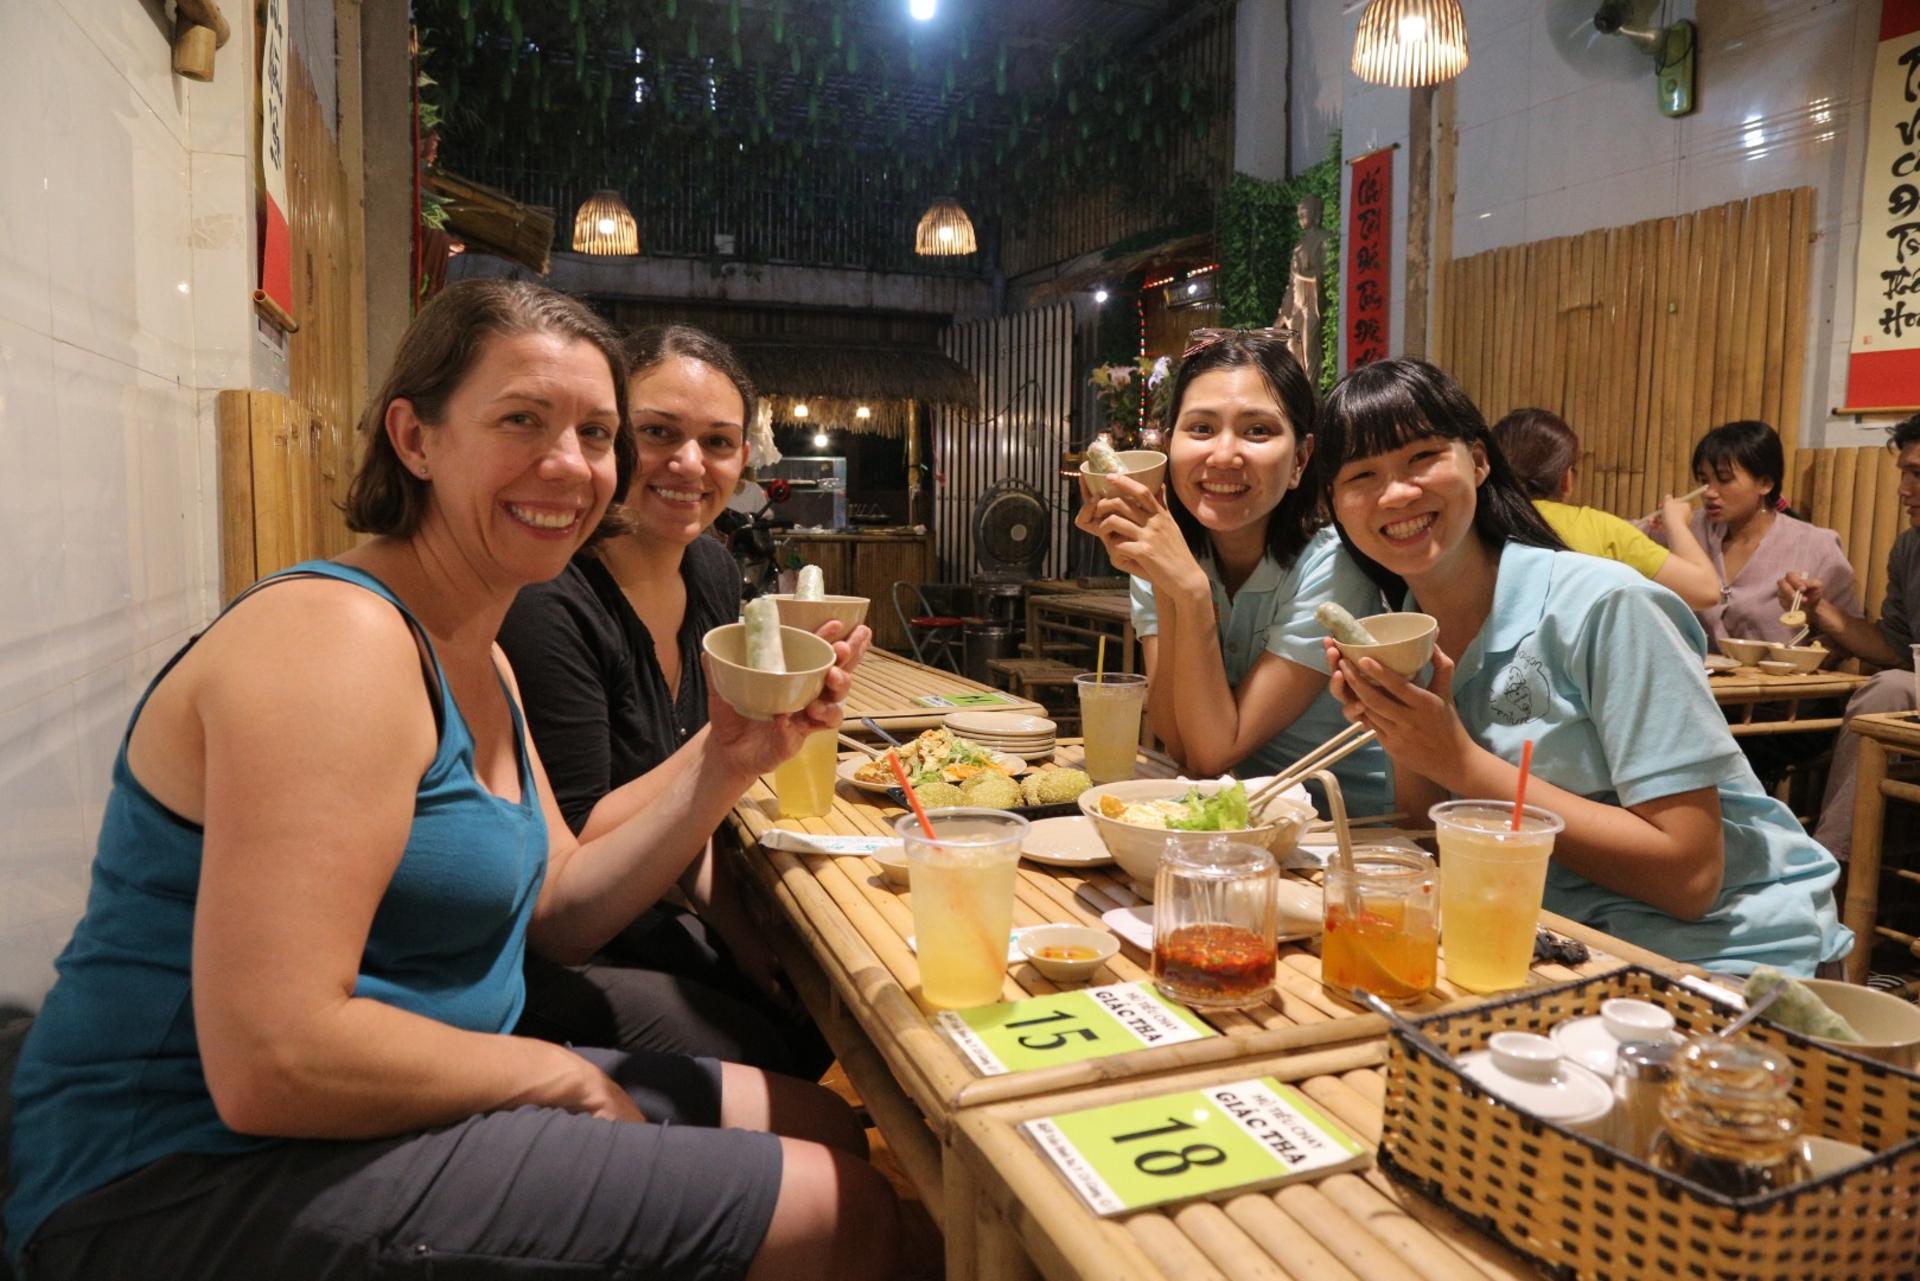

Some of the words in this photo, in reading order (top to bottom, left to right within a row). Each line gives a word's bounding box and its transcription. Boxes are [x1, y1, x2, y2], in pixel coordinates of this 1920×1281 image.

[1004, 1010, 1099, 1050] 15
[1127, 1018, 1163, 1042] THA
[1111, 1117, 1227, 1176] 18
[1261, 1130, 1306, 1165] THA
